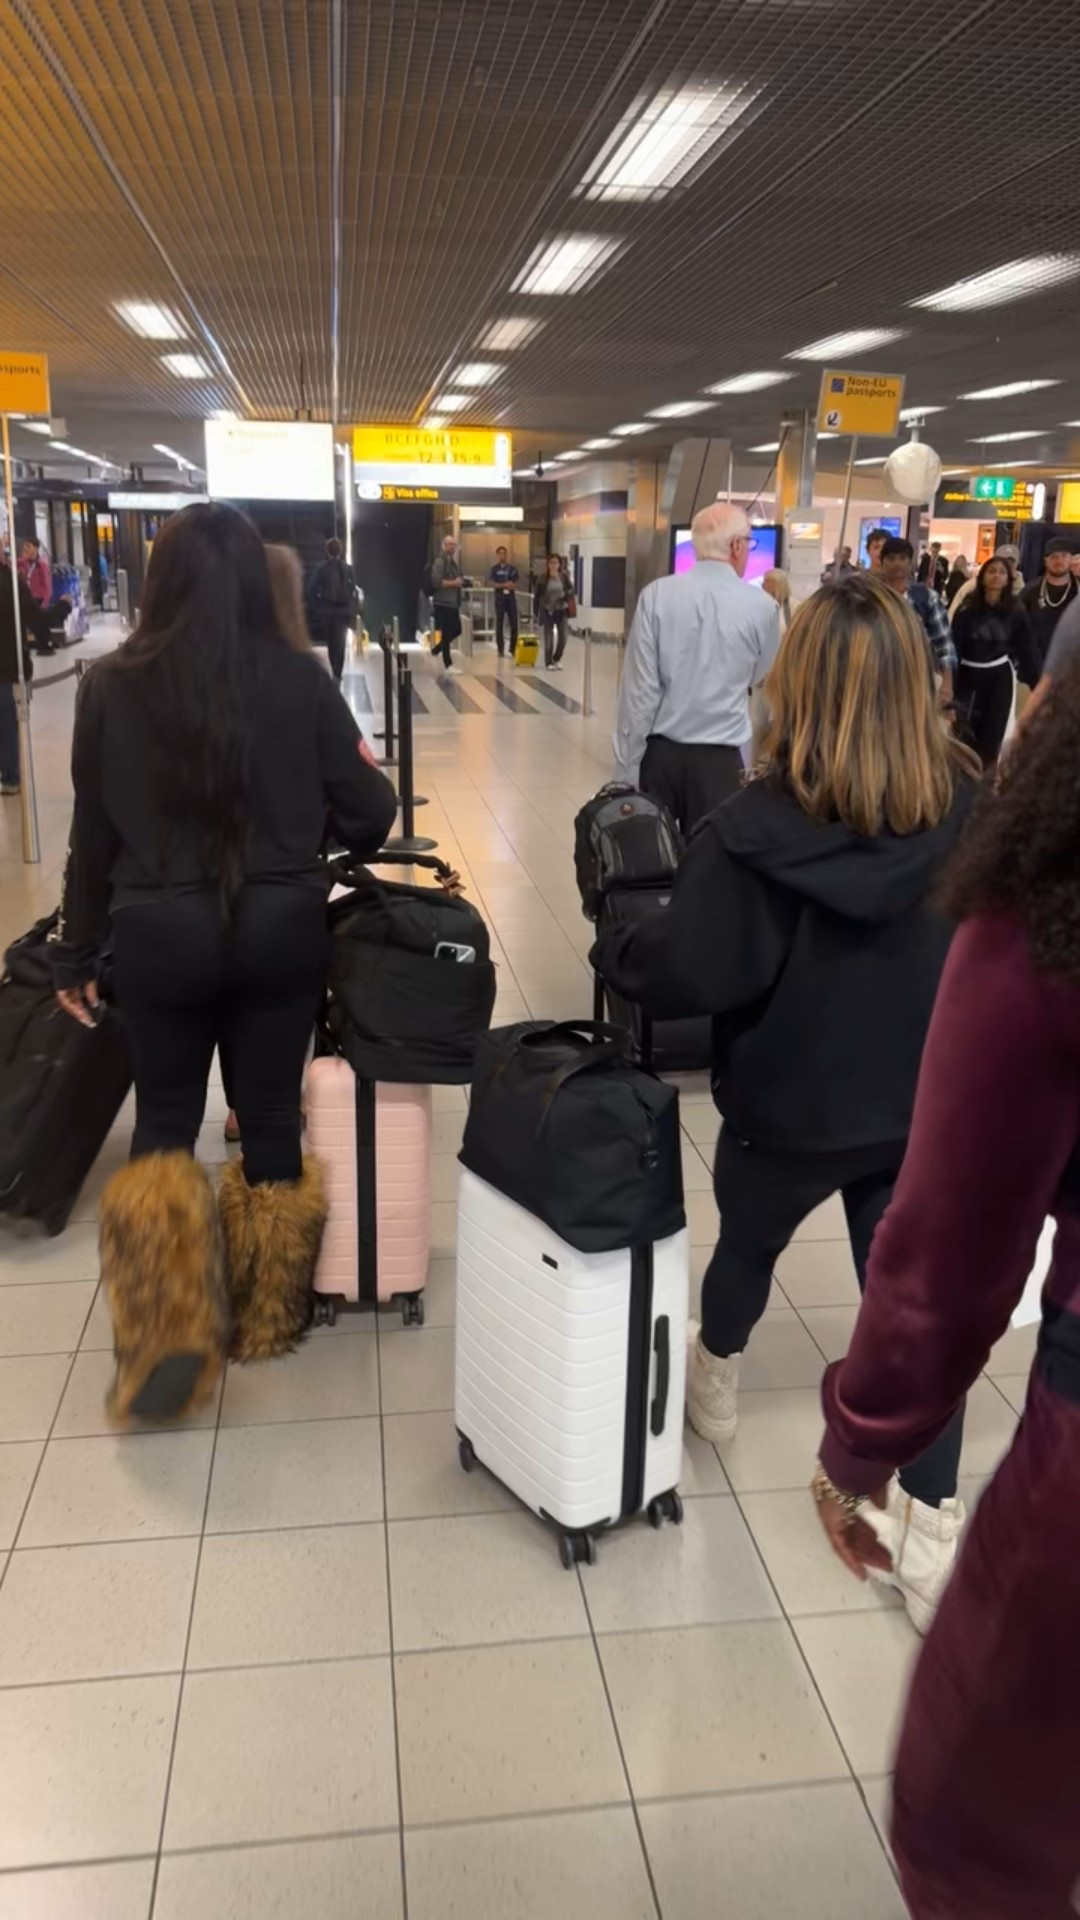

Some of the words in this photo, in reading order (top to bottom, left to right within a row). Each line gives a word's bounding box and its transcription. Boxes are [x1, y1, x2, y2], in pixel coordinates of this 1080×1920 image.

[848, 377, 888, 388] Non-EU
[846, 387, 896, 398] passports
[396, 488, 414, 498] Visa
[415, 488, 439, 499] office
